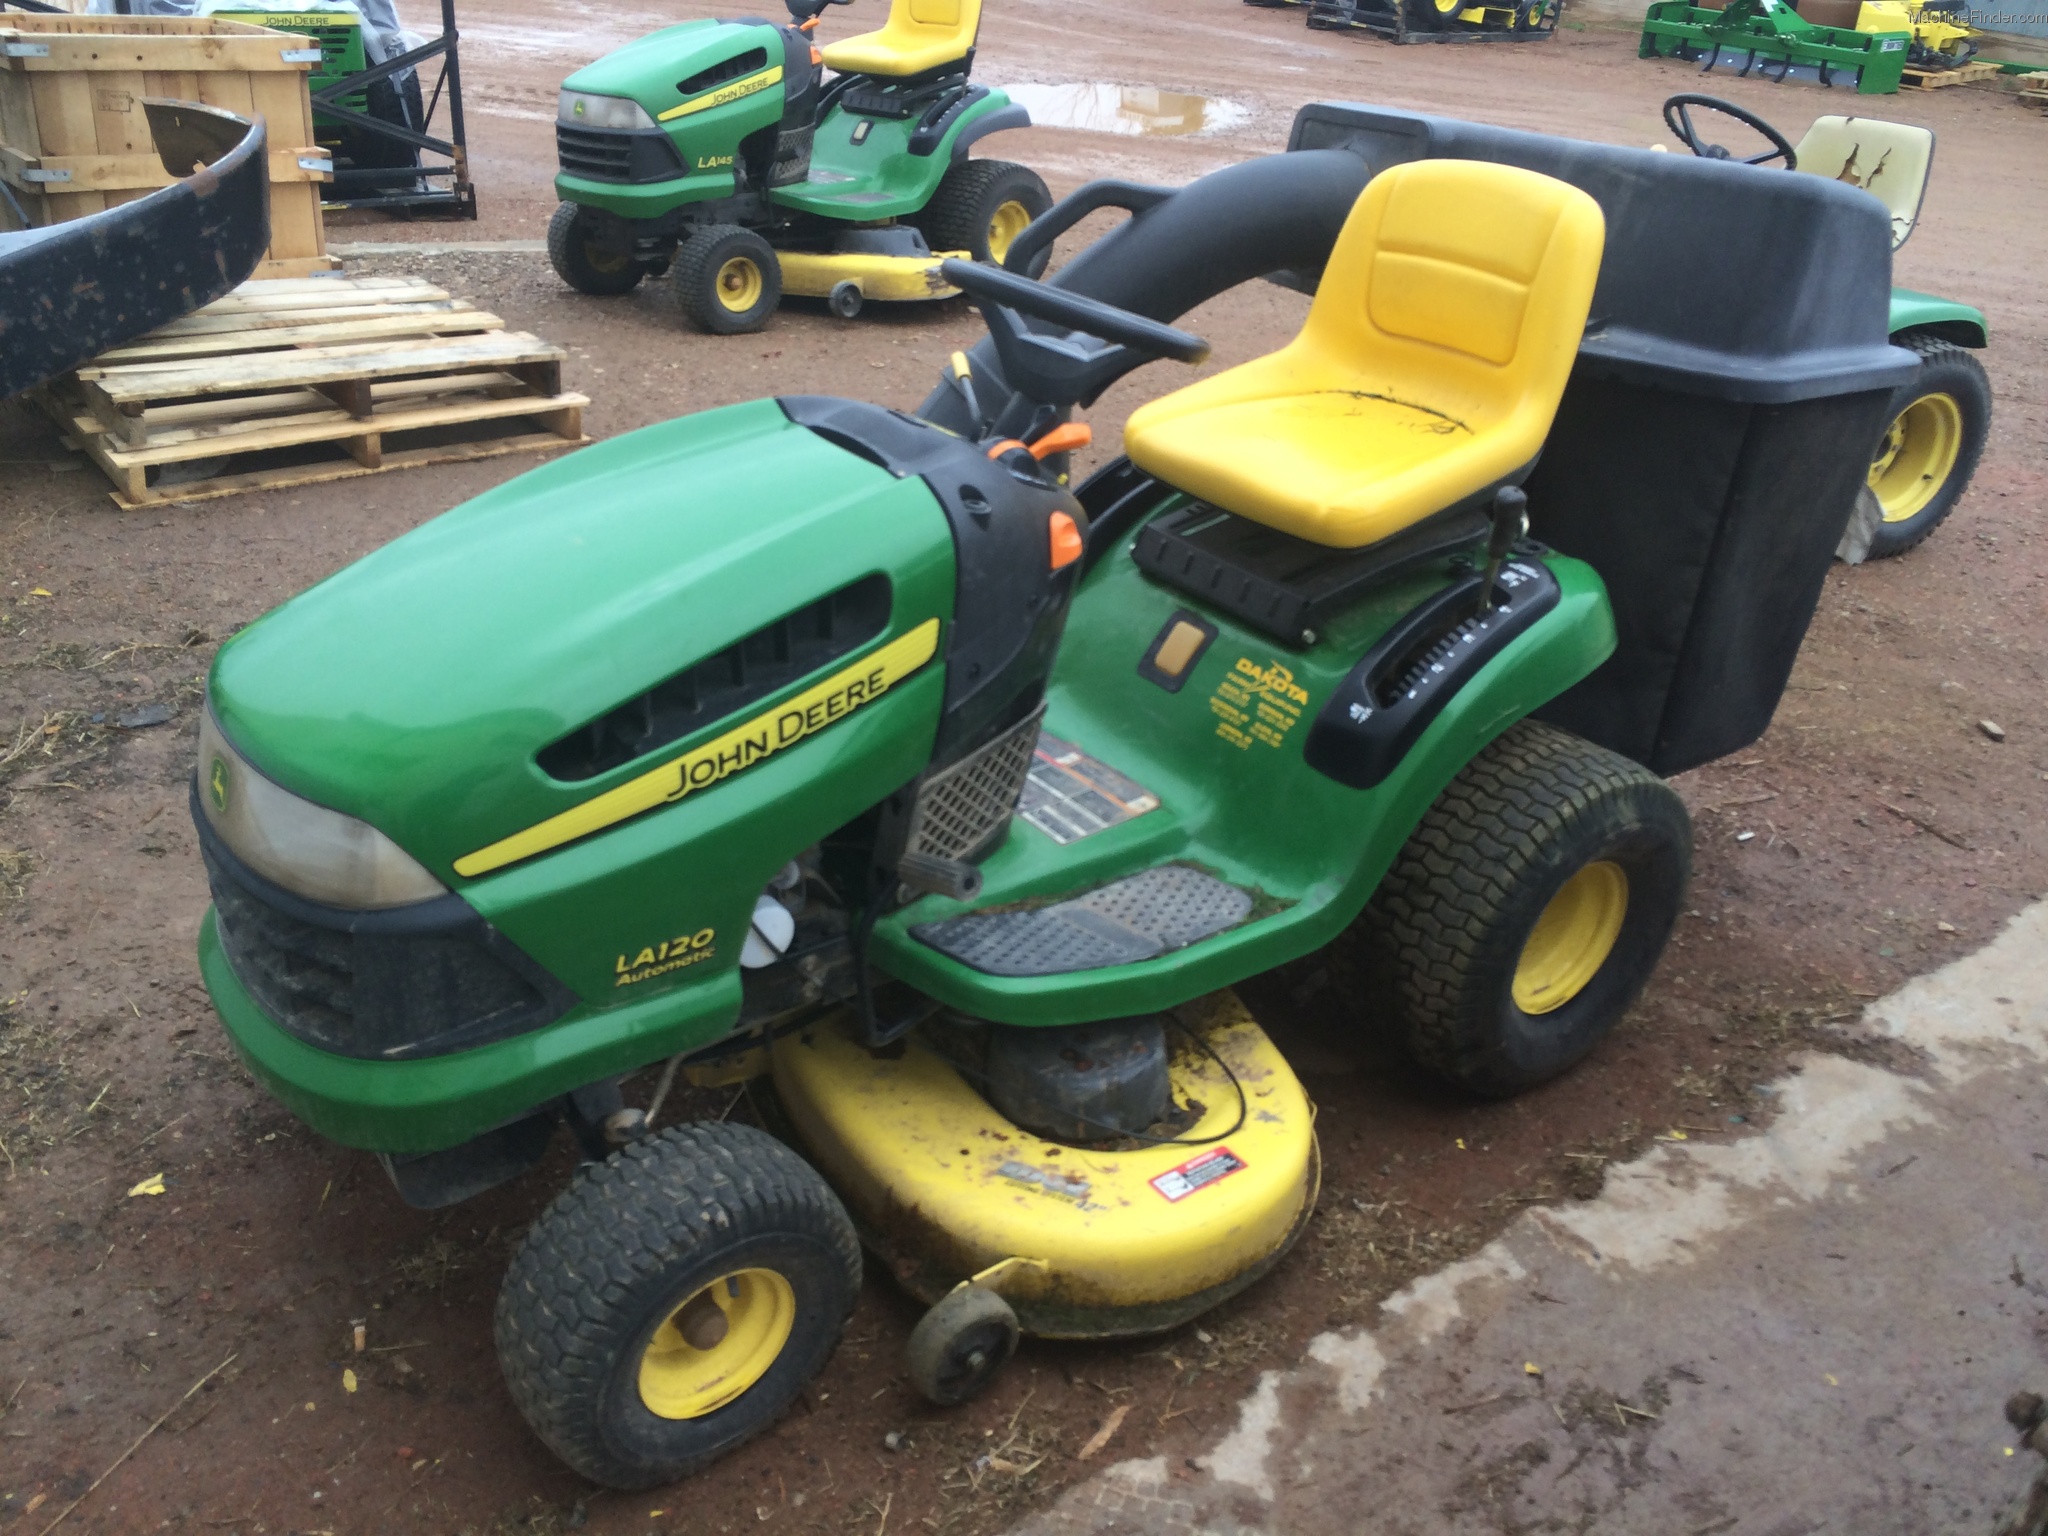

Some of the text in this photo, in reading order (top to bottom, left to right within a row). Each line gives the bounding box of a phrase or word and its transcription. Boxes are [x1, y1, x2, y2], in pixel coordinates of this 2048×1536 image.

[263, 16, 330, 25] JOHN DEERE
[711, 78, 768, 105] JOHN DEERE
[697, 156, 733, 169] LA145
[1235, 657, 1309, 705] DAKOTA
[666, 667, 888, 798] JOHN DEERE
[615, 927, 716, 974] LA120
[615, 946, 717, 987] Automatic
